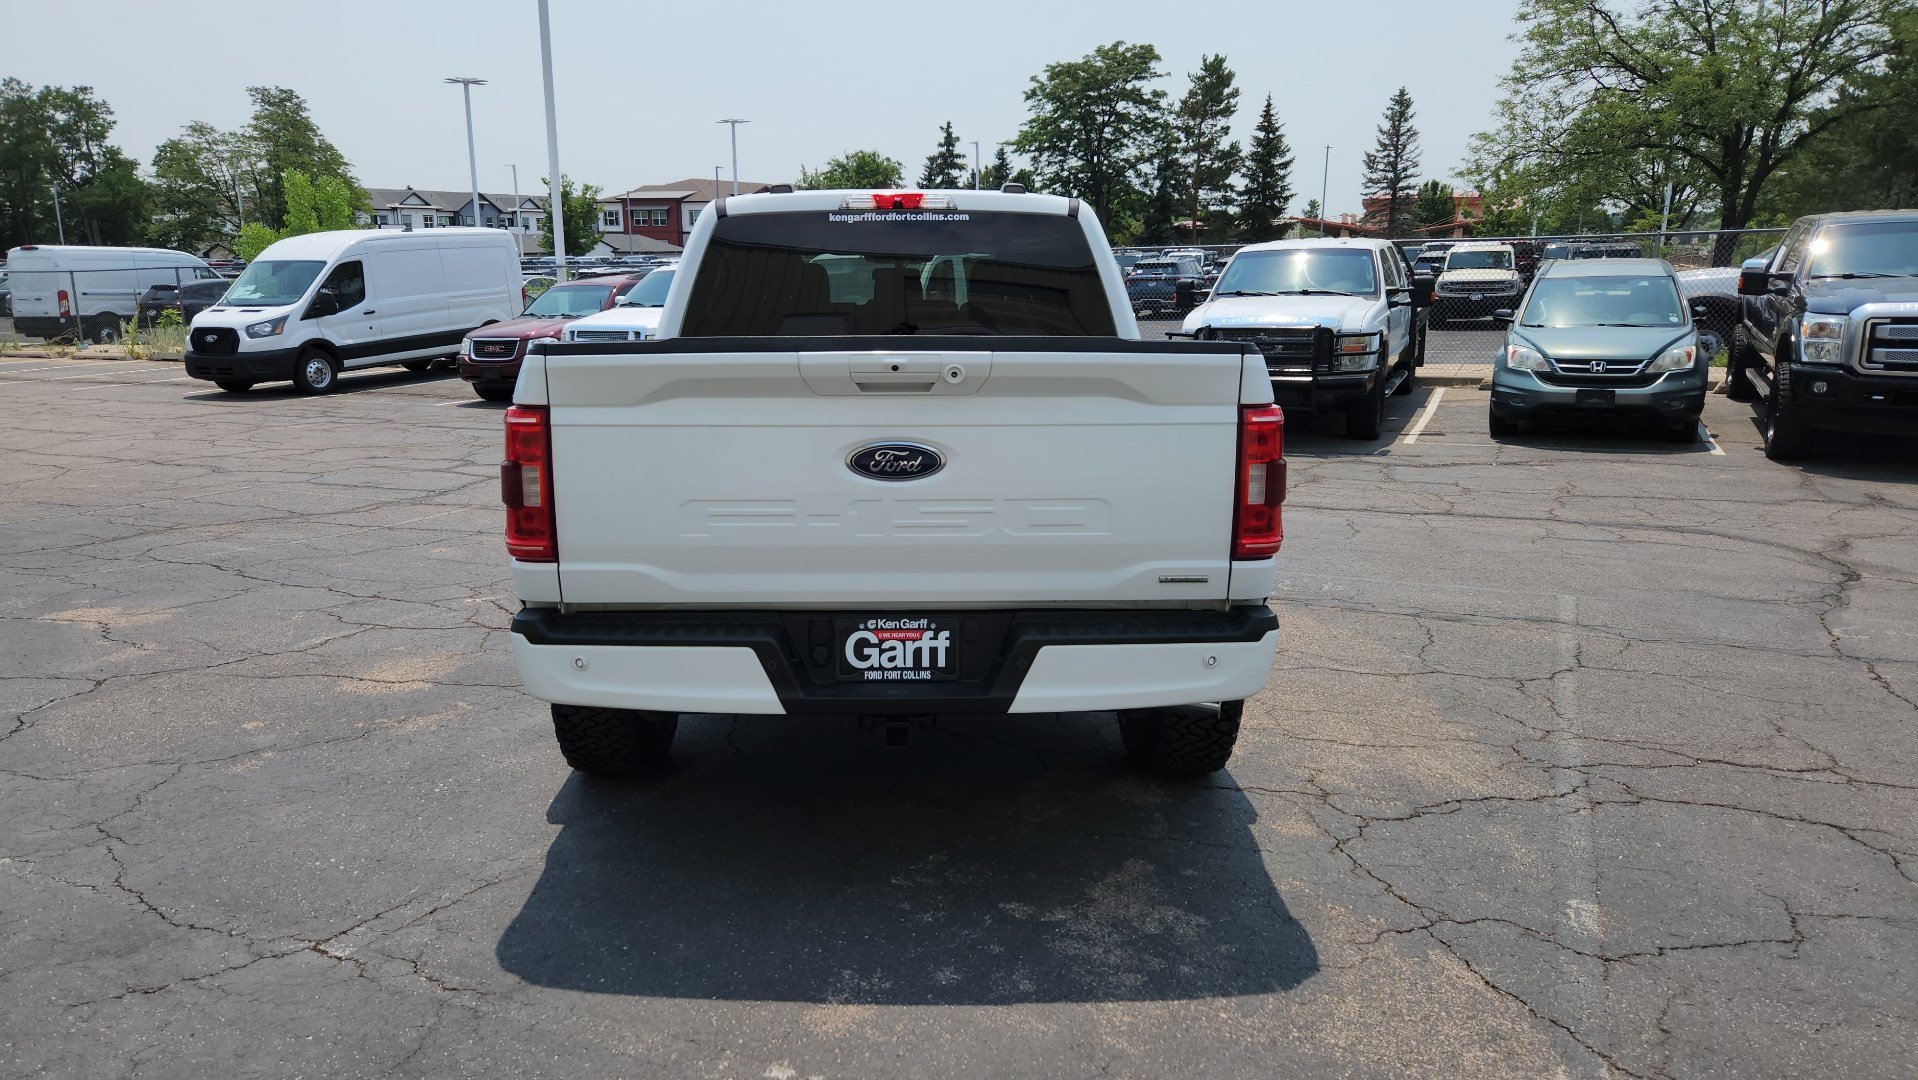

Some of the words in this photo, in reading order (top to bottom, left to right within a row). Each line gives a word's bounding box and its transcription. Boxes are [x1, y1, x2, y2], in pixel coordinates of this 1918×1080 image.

[829, 213, 969, 223] kengarfffordfortcollins.com
[869, 449, 923, 472] Ford
[679, 498, 1112, 537] F-150
[877, 618, 899, 629] Ken
[900, 618, 928, 629] Garff
[845, 630, 950, 669] Garff
[864, 670, 883, 680] FORD
[884, 670, 901, 680] FORT
[902, 670, 931, 680] COLLINS
